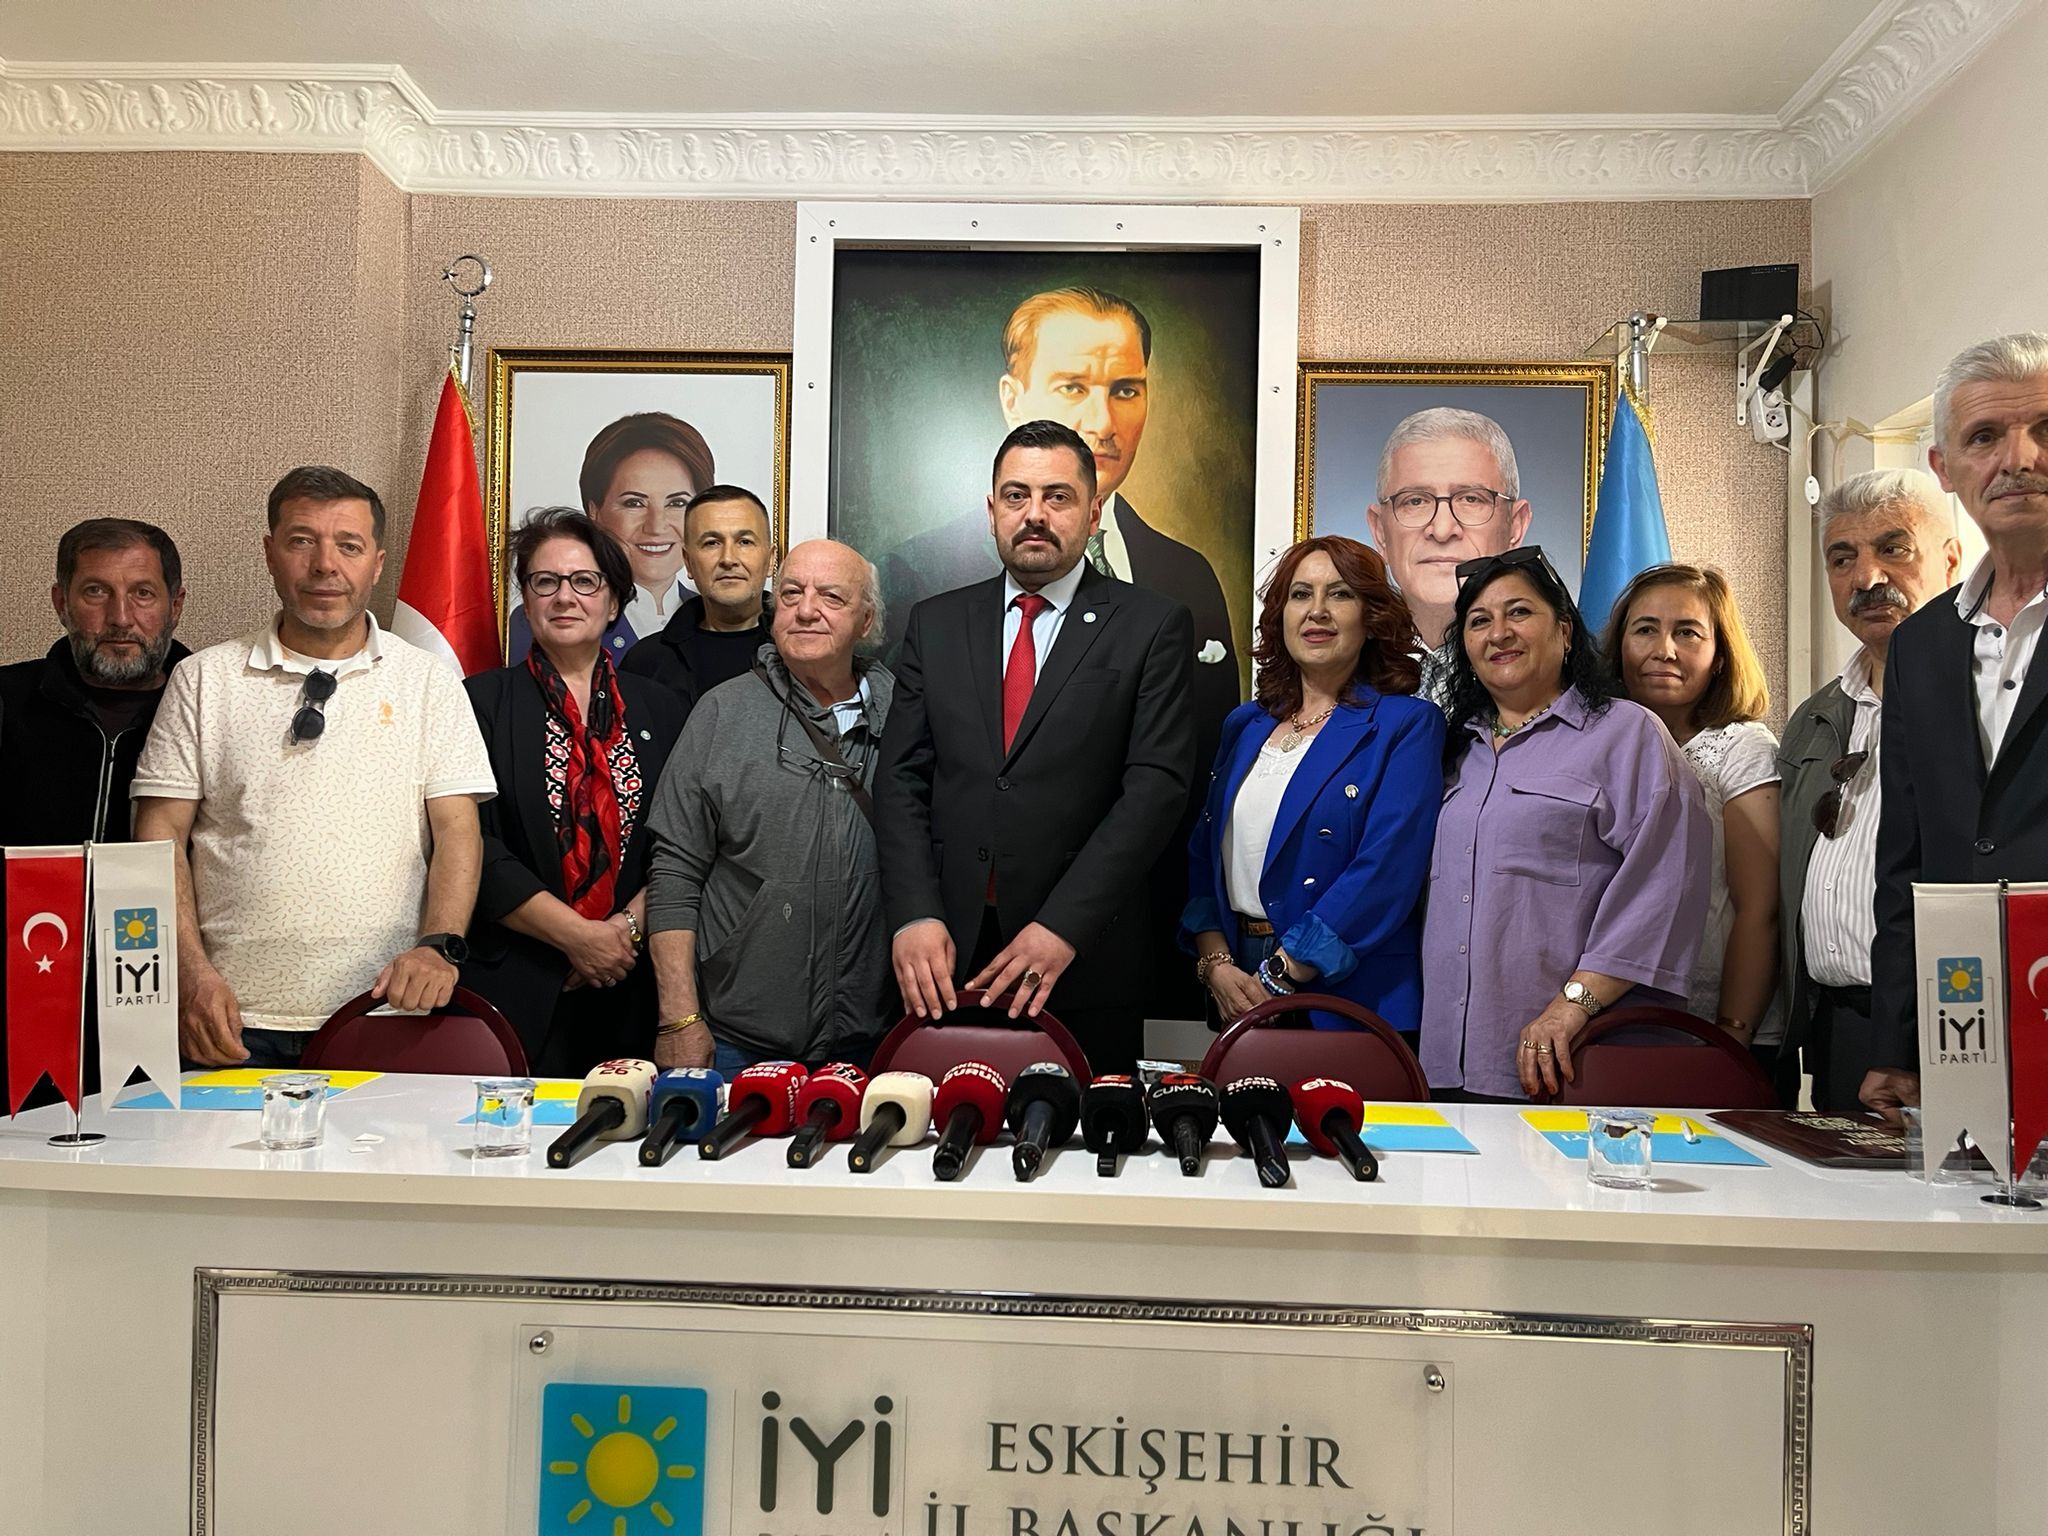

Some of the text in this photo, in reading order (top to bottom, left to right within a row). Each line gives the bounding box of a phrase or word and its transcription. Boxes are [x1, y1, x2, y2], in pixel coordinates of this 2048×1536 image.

[115, 954, 160, 994] İYİ
[116, 993, 160, 1006] PARTİ
[1938, 1008, 1985, 1051] İYİ
[1940, 1050, 1987, 1064] PARTİ
[759, 1390, 895, 1518] İYİ
[986, 1416, 1354, 1495] ESKİŞEHİR
